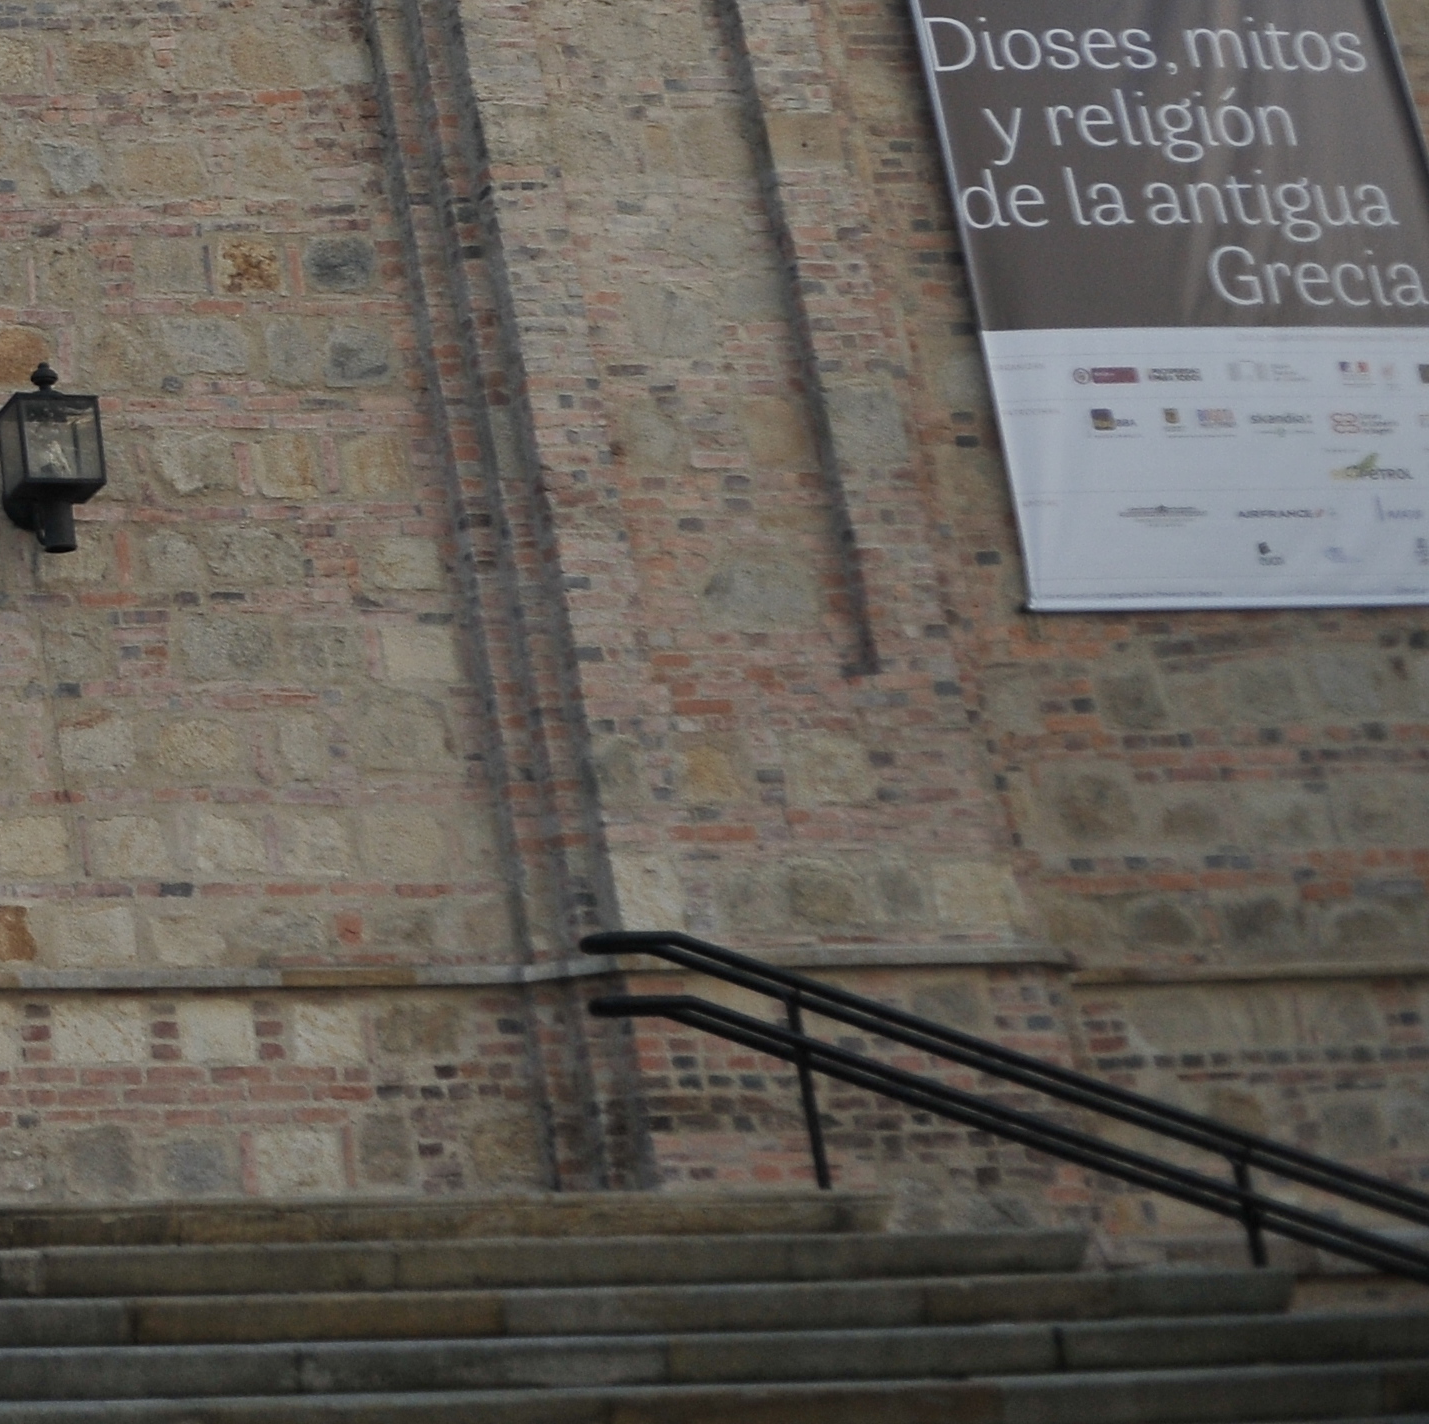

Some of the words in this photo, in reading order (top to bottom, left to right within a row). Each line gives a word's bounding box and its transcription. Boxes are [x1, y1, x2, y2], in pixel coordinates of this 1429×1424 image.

[923, 16, 1178, 75] Dioses,
[1184, 16, 1367, 72] mitos
[982, 107, 1022, 166] y
[1045, 87, 1298, 163] religión
[961, 168, 1049, 230] de
[1062, 166, 1135, 226] la
[1143, 168, 1401, 243] antigua
[1208, 245, 1429, 306] Grecia
